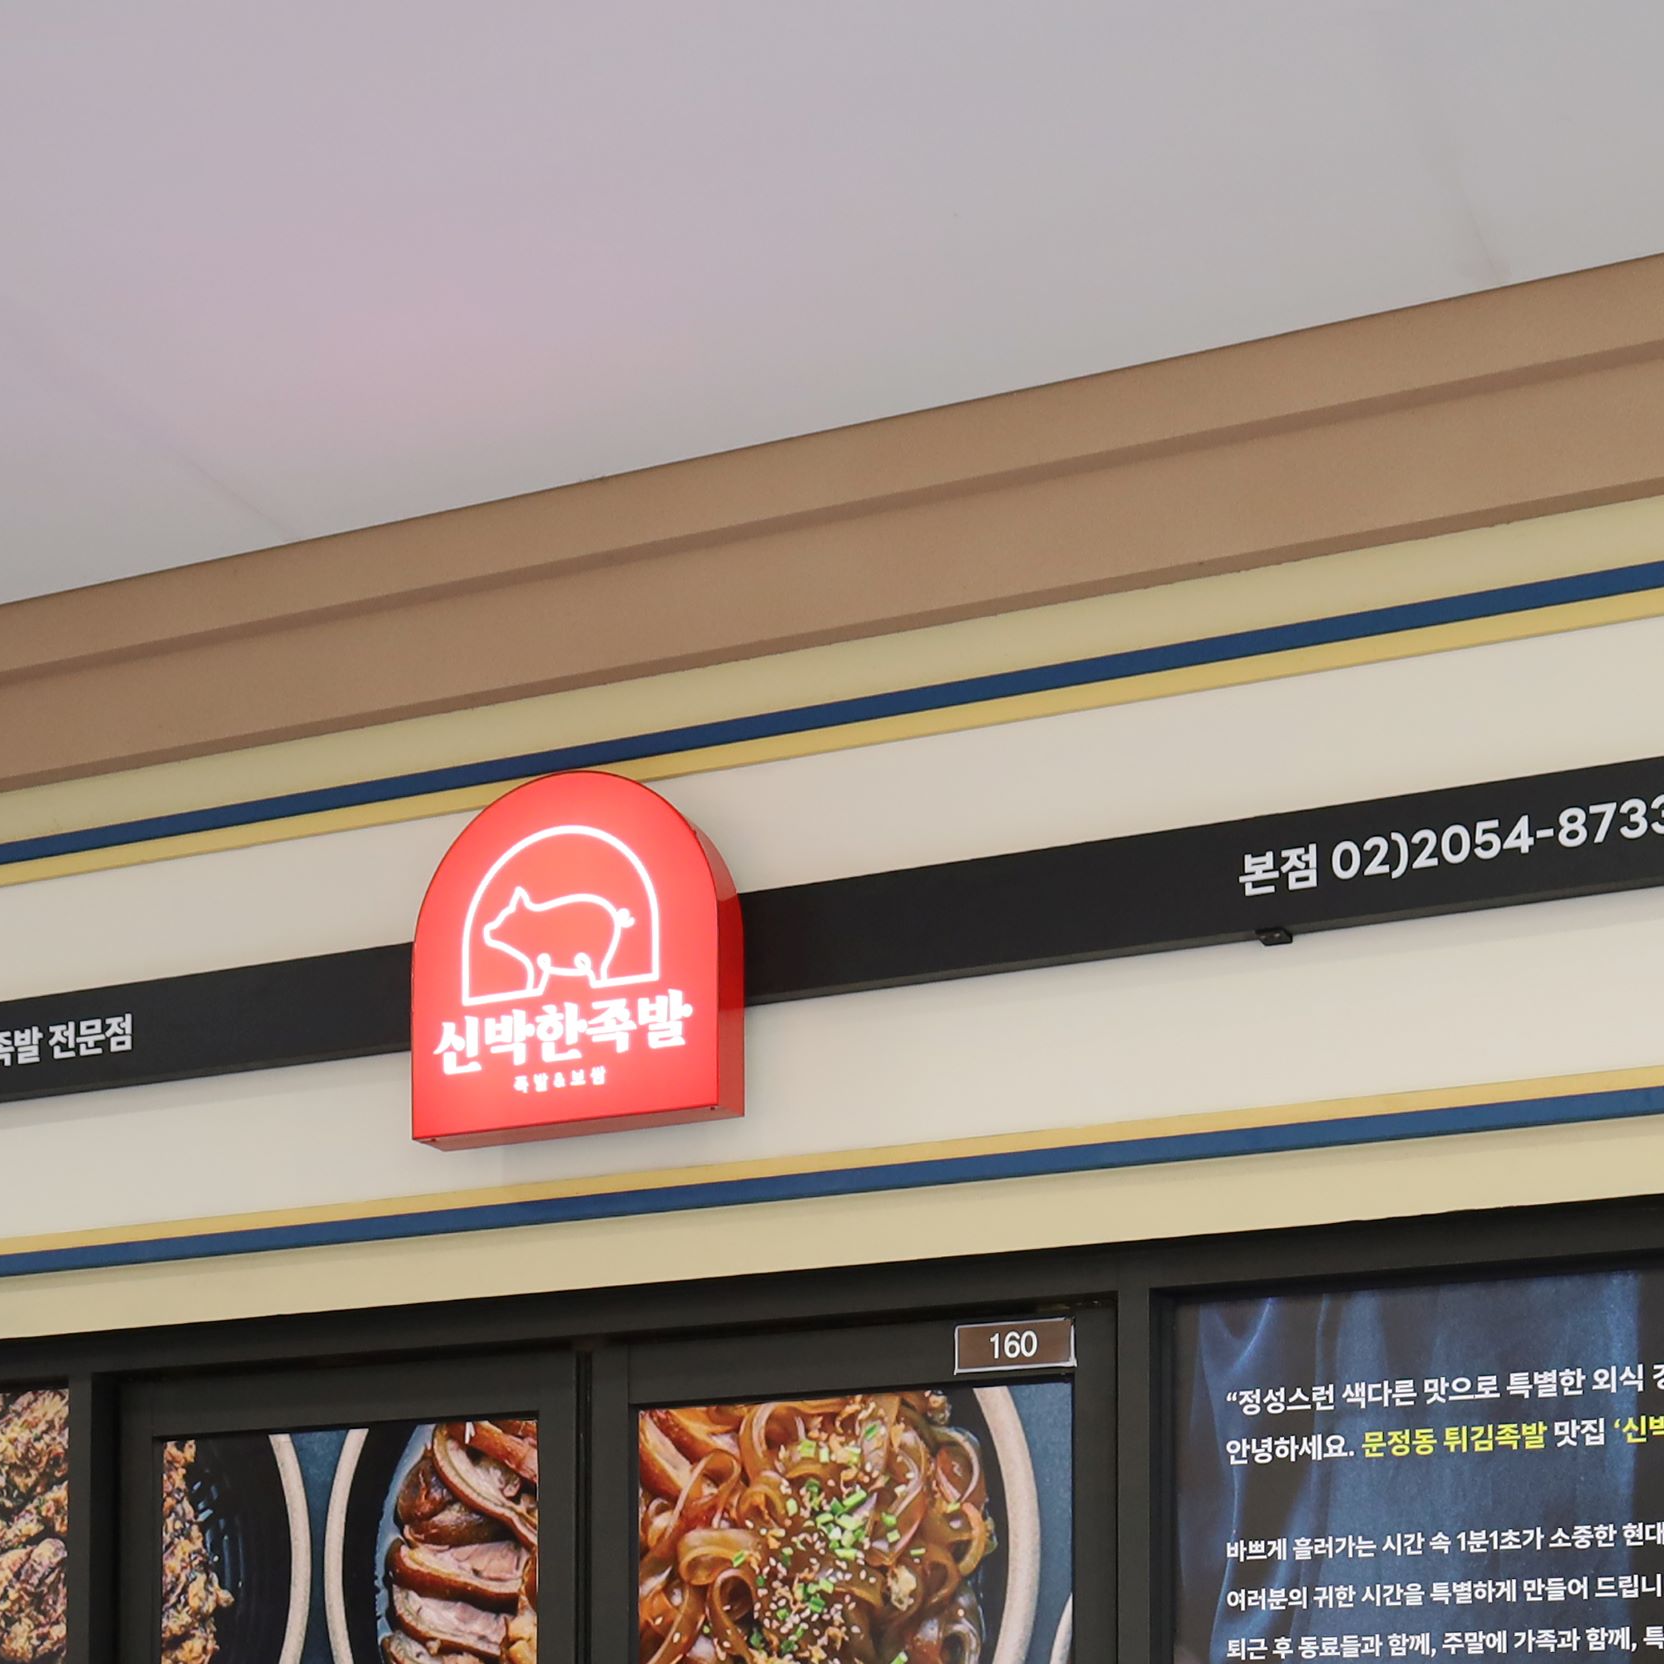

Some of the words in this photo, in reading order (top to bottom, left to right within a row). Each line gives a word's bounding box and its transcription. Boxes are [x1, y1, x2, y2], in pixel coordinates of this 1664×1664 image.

[1238, 842, 1318, 896] 본점
[49, 1013, 134, 1060] 전문점
[433, 988, 693, 1075] 신박한족발
[989, 1330, 1038, 1359] 160
[1341, 1378, 1418, 1410] 색다른
[1423, 1374, 1501, 1405] 맛으로
[1505, 1367, 1587, 1400] 특별한
[1591, 1363, 1644, 1394] 외식
[1225, 1433, 1355, 1466] 안녕하세요.
[1360, 1427, 1438, 1459] 문정동
[1442, 1420, 1549, 1454] 튀김족발
[1553, 1417, 1605, 1448] 맛집
[1225, 1537, 1288, 1563] 바쁘게
[1292, 1534, 1378, 1561] 흘러가는
[1381, 1531, 1426, 1557] 시간
[1428, 1531, 1452, 1555] 속
[1548, 1523, 1618, 1550] 소중한
[1225, 1587, 1308, 1612] 여러분의
[1312, 1584, 1357, 1609] 귀한
[1360, 1582, 1426, 1607] 시간을
[1429, 1578, 1517, 1605] 특별하게
[1522, 1575, 1589, 1602] 만들어
[1226, 1637, 1269, 1661] 퇴근
[1271, 1636, 1294, 1660] 후
[1297, 1633, 1384, 1660] 동료들과
[1386, 1632, 1437, 1658] 함께,
[1441, 1629, 1508, 1655] 주말에
[1513, 1627, 1582, 1654] 가족과
[1584, 1625, 1638, 1653] 함께,
